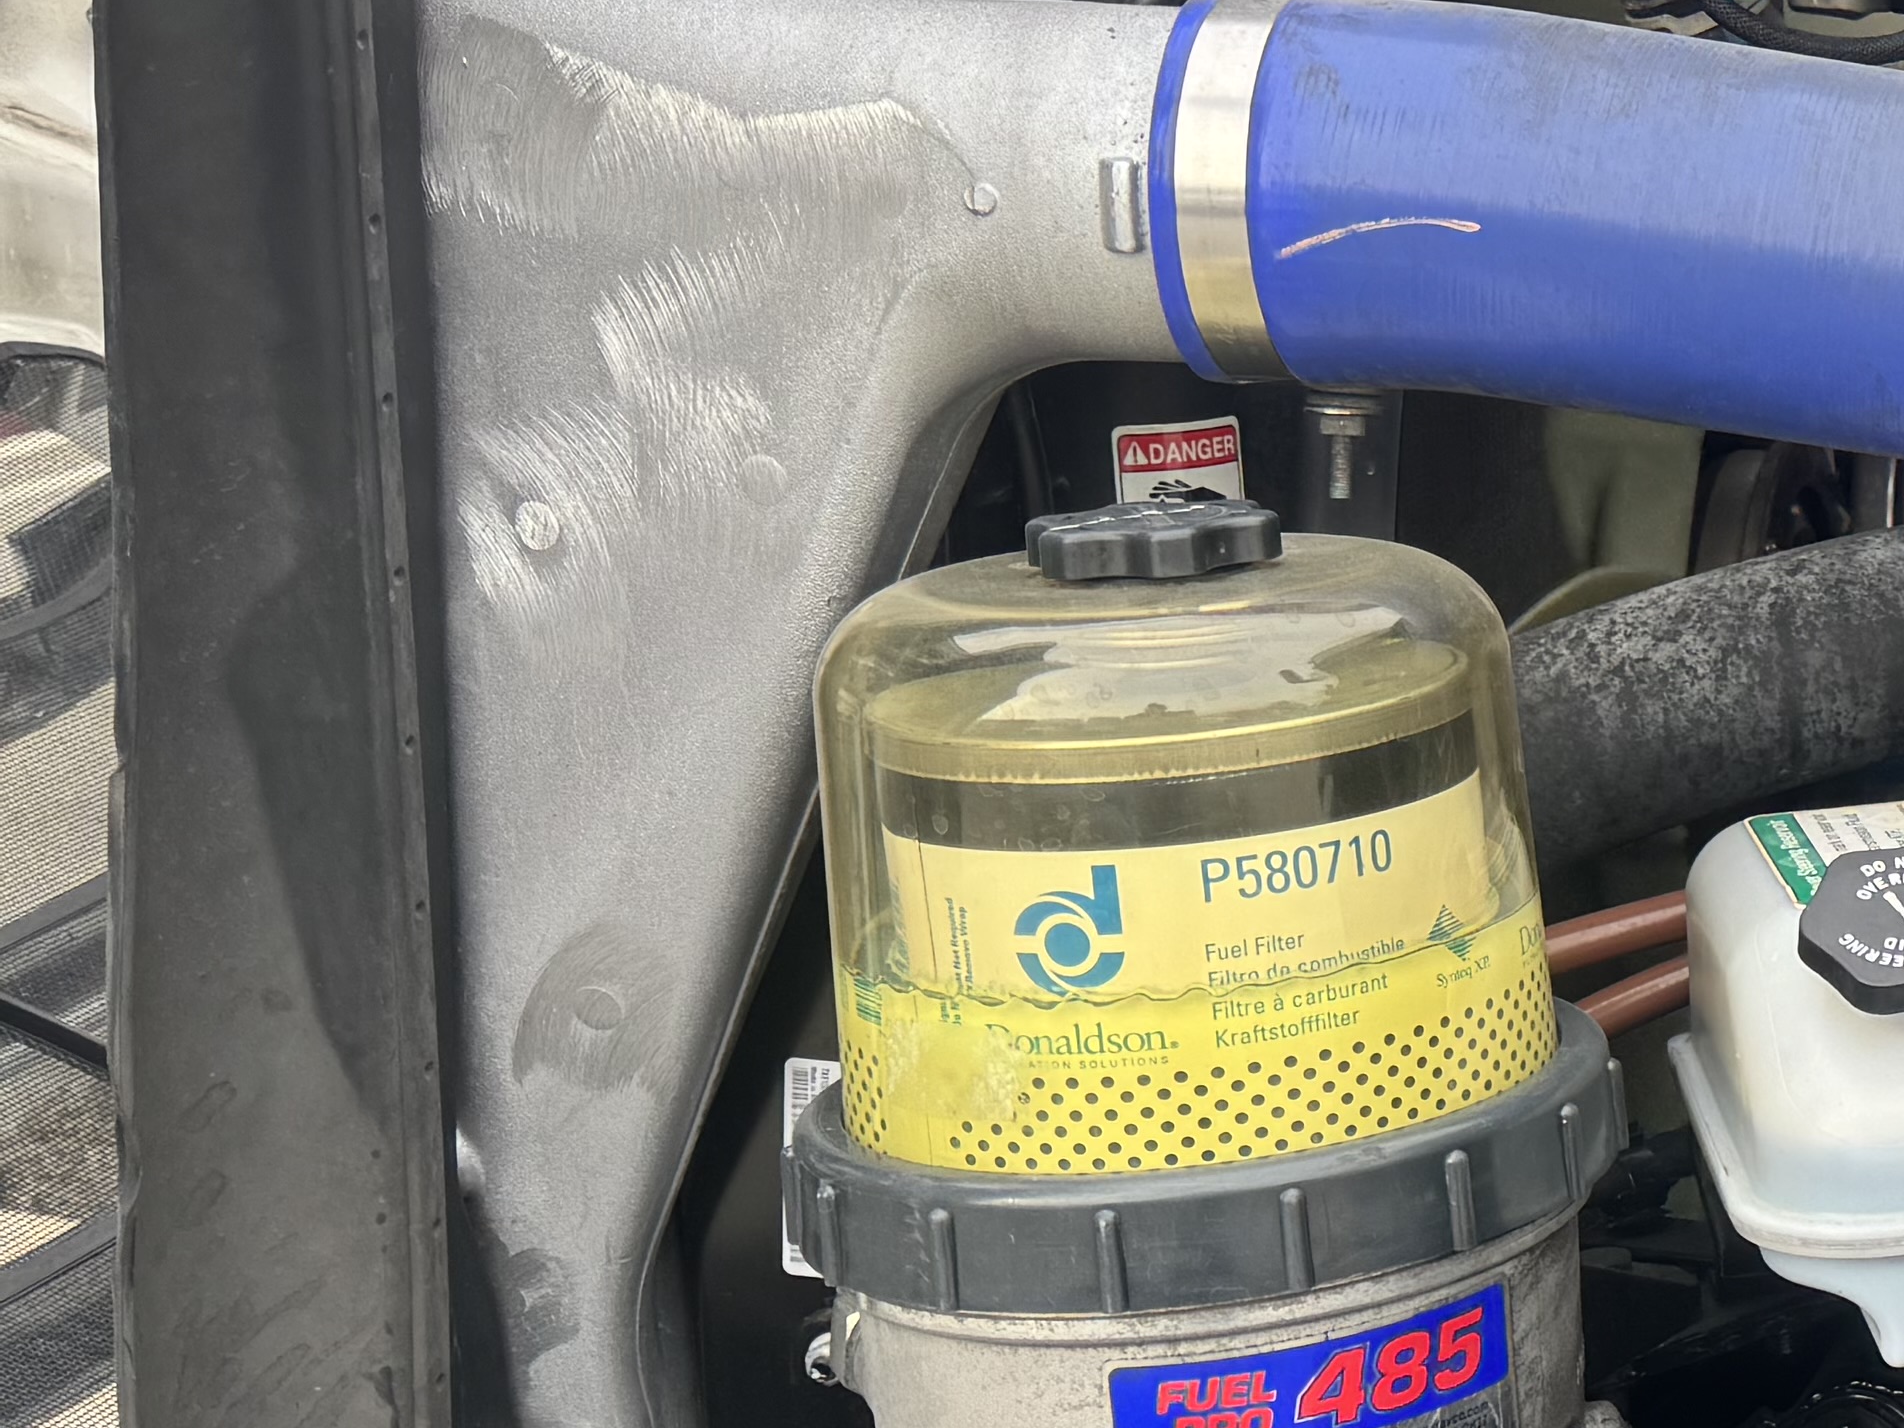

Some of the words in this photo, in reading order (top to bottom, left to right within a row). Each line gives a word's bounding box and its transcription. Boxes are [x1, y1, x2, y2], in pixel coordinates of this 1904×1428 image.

[1149, 435, 1235, 464] DANGER
[1200, 828, 1392, 903] P580710
[1860, 860, 1886, 877] DO
[1205, 939, 1248, 962] Fuel
[1255, 933, 1305, 956] Filter
[1212, 996, 1265, 1021] Filtre
[1274, 993, 1285, 1012] à
[1292, 973, 1389, 1009] carburant
[985, 1022, 1169, 1055] onaldson
[1215, 1010, 1361, 1049] Kraftstofffilter
[1080, 1056, 1169, 1070] SOLUTIONS
[1294, 1306, 1484, 1427] 485
[1156, 1370, 1277, 1416] FUEL
